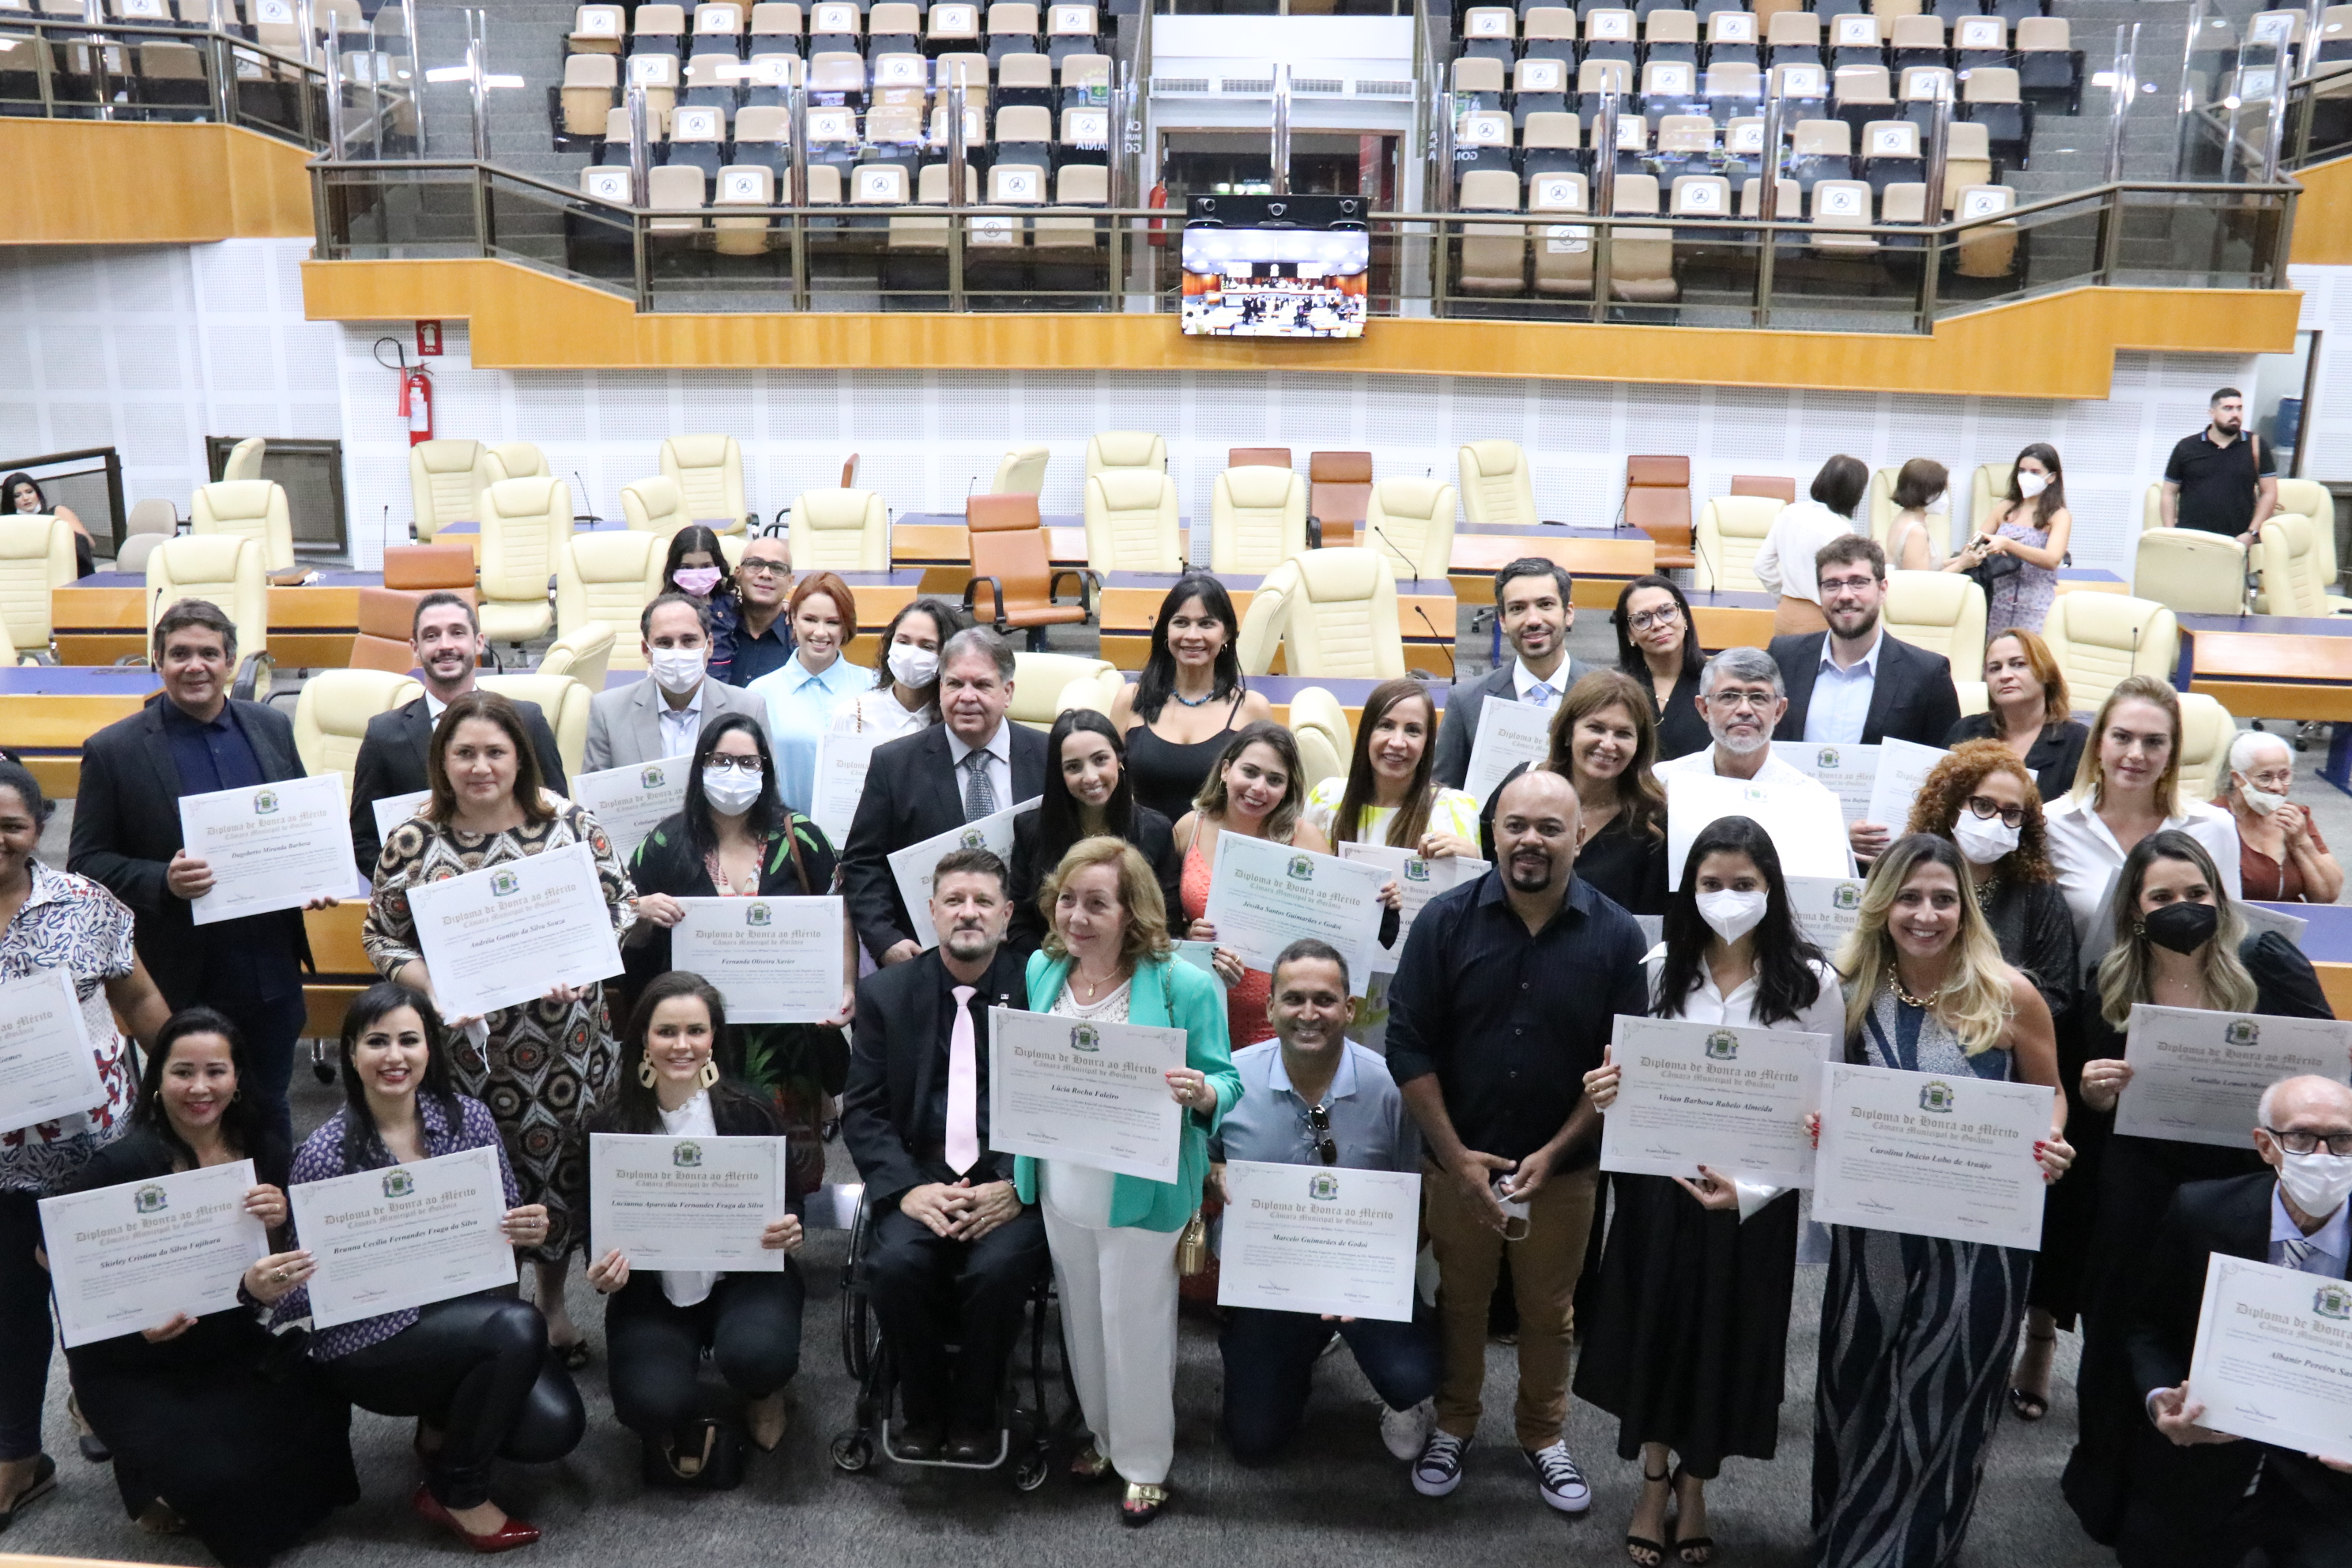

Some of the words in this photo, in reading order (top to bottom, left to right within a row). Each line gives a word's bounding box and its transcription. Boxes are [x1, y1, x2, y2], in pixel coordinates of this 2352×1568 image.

[1497, 728, 1532, 742] Diploma
[599, 797, 633, 809] Diploma
[206, 824, 243, 836] Diploma
[258, 817, 285, 827] Honra
[300, 810, 327, 821] Mérito
[232, 850, 262, 858] Dagoberto
[1234, 869, 1271, 884] Diploma
[1274, 879, 1283, 888] de
[1287, 881, 1314, 895] Honra
[1329, 892, 1360, 906] Mérito
[441, 910, 482, 926] Diploma
[497, 897, 529, 910] Honra
[532, 893, 541, 902] ao
[545, 884, 576, 899] Mérito
[1243, 901, 1264, 910] Jéssika
[1266, 906, 1284, 916] Santos
[1286, 912, 1317, 924] Guimarães
[1323, 921, 1341, 930] Godoi
[496, 932, 519, 940] Gontijo
[547, 919, 565, 928] Souza
[695, 930, 733, 939] Diploma
[748, 929, 775, 938] Honra
[791, 929, 821, 938] Mérito
[17, 1012, 53, 1029] Mérito
[1014, 1046, 1054, 1061] Diploma
[1058, 1053, 1069, 1062] de
[1072, 1054, 1104, 1068] Honra
[1122, 1061, 1157, 1075] Mérito
[1033, 1060, 1061, 1069] Câmara
[1062, 1065, 1097, 1075] Municipal
[1109, 1071, 1136, 1080] Goiânia
[1640, 1056, 1687, 1070] Diploma
[1690, 1062, 1702, 1072] de
[1706, 1063, 1741, 1076] Honra
[1760, 1069, 1799, 1082] Mérito
[1660, 1070, 1690, 1080] Câmara
[1693, 1074, 1732, 1084] Municipal
[1744, 1079, 1775, 1089] Goiânia
[1072, 1087, 1093, 1096] Rocha
[1095, 1091, 1119, 1099] Faleiro
[1659, 1094, 1682, 1102] Vivian
[1683, 1096, 1713, 1106] Barbosa
[1743, 1103, 1773, 1112] Almeida
[1851, 1106, 1899, 1122] Diploma
[1903, 1114, 1915, 1125] de
[1920, 1115, 1957, 1130] Honra
[1961, 1124, 1973, 1133] ao
[1977, 1124, 2019, 1139] Mérito
[1872, 1121, 1904, 1133] Câmara
[1905, 1126, 1947, 1138] Municipal
[1961, 1133, 1994, 1145] Goiânia
[1870, 1147, 1903, 1157] Carolina
[1905, 1151, 1930, 1160] Inácio
[1966, 1160, 1992, 1170] Araújo
[616, 1170, 658, 1179] Diploma
[676, 1170, 707, 1180] Honra
[725, 1171, 759, 1181] Mérito
[324, 1210, 370, 1225] Diploma
[388, 1200, 422, 1212] Honra
[426, 1197, 437, 1205] ao
[441, 1189, 476, 1203] Mérito
[1251, 1199, 1292, 1211] Diploma
[1296, 1203, 1306, 1212] de
[1310, 1203, 1341, 1215] Honra
[1359, 1208, 1393, 1219] Mérito
[74, 1226, 122, 1243] Diploma
[141, 1215, 176, 1227] Honra
[196, 1203, 232, 1217] Mérito
[1299, 1214, 1333, 1223] Municipal
[334, 1245, 361, 1254] Brunna
[390, 1231, 426, 1243] Fernandes
[100, 1259, 126, 1268] Shirley
[128, 1253, 157, 1262] Cristina
[2235, 1302, 2290, 1325] Diploma
[2294, 1317, 2308, 1329] de
[2304, 1359, 2336, 1374] Pereira
